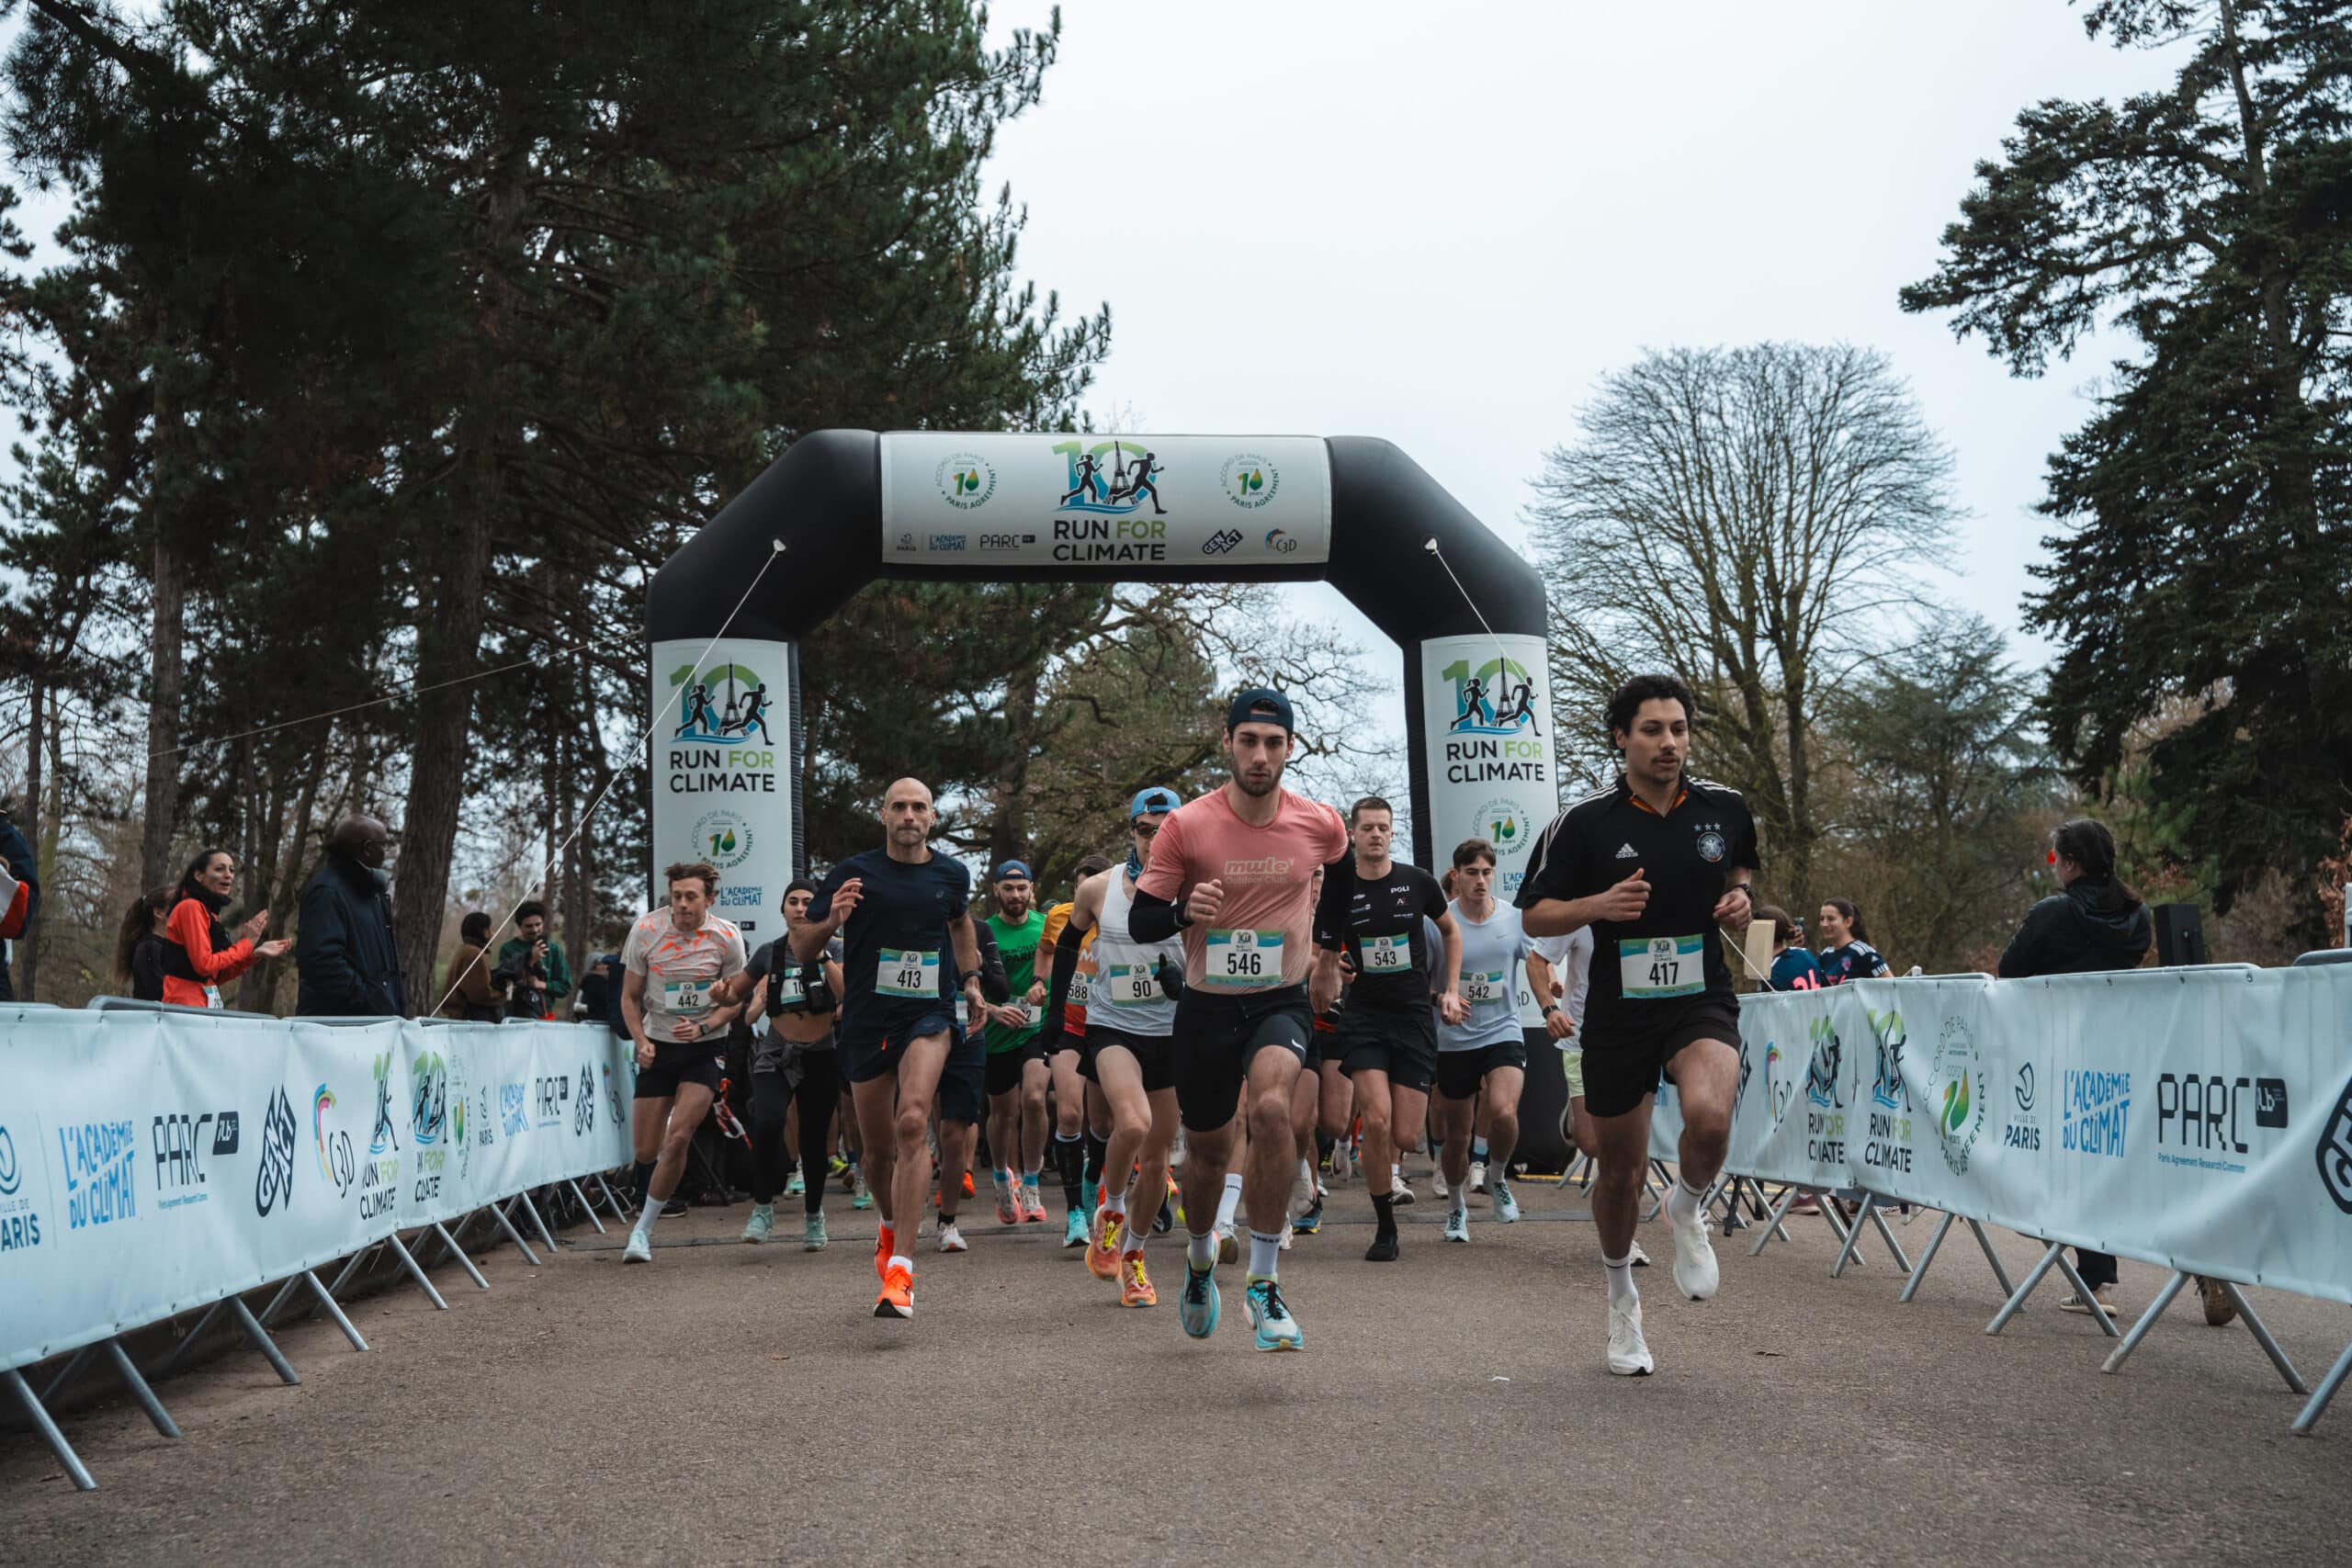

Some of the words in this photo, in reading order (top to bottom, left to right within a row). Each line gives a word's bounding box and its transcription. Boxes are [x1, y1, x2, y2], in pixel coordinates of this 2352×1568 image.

[945, 495, 967, 510] PARIS
[970, 468, 997, 509] AGREEMENT
[1230, 495, 1252, 509] PARIS
[1254, 468, 1279, 508] AGREEMENT
[1054, 520, 1108, 539] RUN
[1116, 520, 1166, 539] FOR
[979, 535, 1020, 548] PARC
[1053, 544, 1166, 561] CLIMATE
[670, 750, 720, 770] RUN
[728, 750, 774, 769] FOR
[1446, 740, 1497, 761] RUN
[1504, 740, 1544, 759] FOR
[670, 773, 775, 793] CLIMATE
[1448, 762, 1544, 784] CLIMATE
[726, 829, 753, 869] AGREEMENT
[1227, 953, 1261, 976] 546
[1374, 951, 1396, 966] 543
[897, 970, 922, 988] 413
[1649, 962, 1679, 985] 417
[1069, 985, 1088, 999] 588
[1133, 980, 1151, 998] 90
[1468, 986, 1489, 998] 542
[678, 995, 698, 1008] 442
[1808, 1113, 1825, 1134] RUN
[1825, 1113, 1844, 1136] OR
[2014, 1114, 2029, 1123] VILLE
[2030, 1115, 2036, 1124] DE
[2157, 1073, 2250, 1154] PARC
[1870, 1112, 1891, 1138] RUN
[1893, 1116, 1912, 1142] FOR
[2004, 1124, 2041, 1151] PARIS
[2063, 1121, 2077, 1151] DU
[153, 1113, 212, 1190] PARC
[276, 1093, 294, 1194] ACT
[424, 1151, 446, 1173] FOR
[1865, 1142, 1912, 1173] CLIMATE
[2158, 1152, 2171, 1163] Paris
[2171, 1154, 2199, 1168] Agreement
[2199, 1157, 2222, 1171] Research
[70, 1190, 86, 1229] DU
[359, 1187, 396, 1221] CLIMATE
[1, 1213, 40, 1252] ARIS
